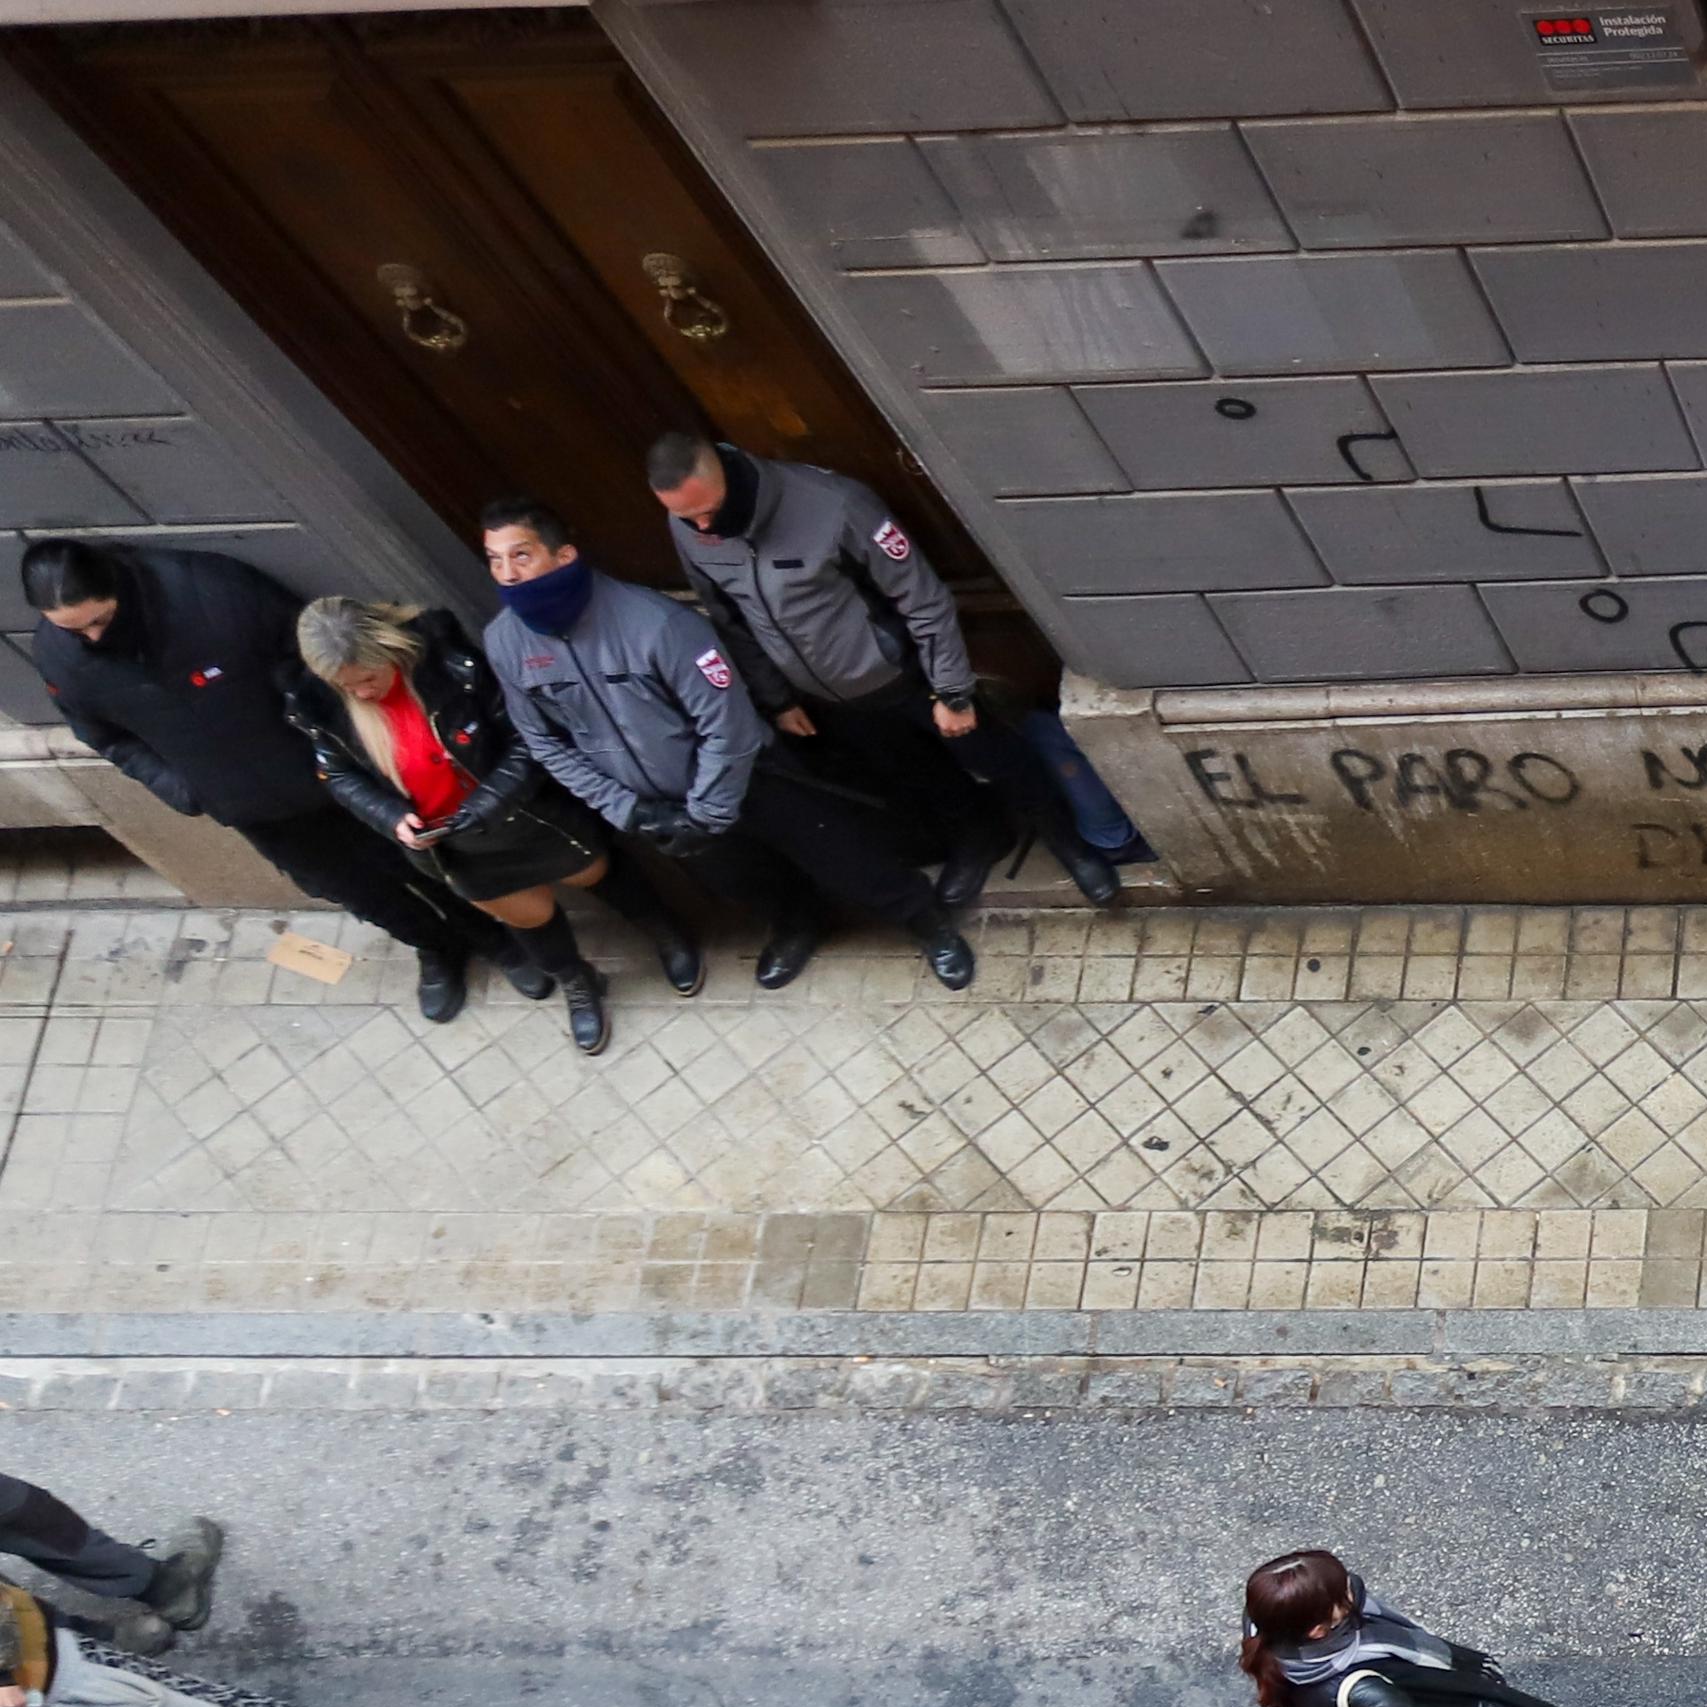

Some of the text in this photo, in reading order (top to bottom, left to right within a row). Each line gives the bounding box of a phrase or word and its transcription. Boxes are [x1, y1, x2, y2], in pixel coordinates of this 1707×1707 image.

[1600, 14, 1666, 27] Instalación
[1604, 26, 1664, 38] Protegida
[1542, 34, 1595, 45] SECURITAS
[1184, 748, 1310, 806] EL
[1330, 747, 1582, 812] PARO
